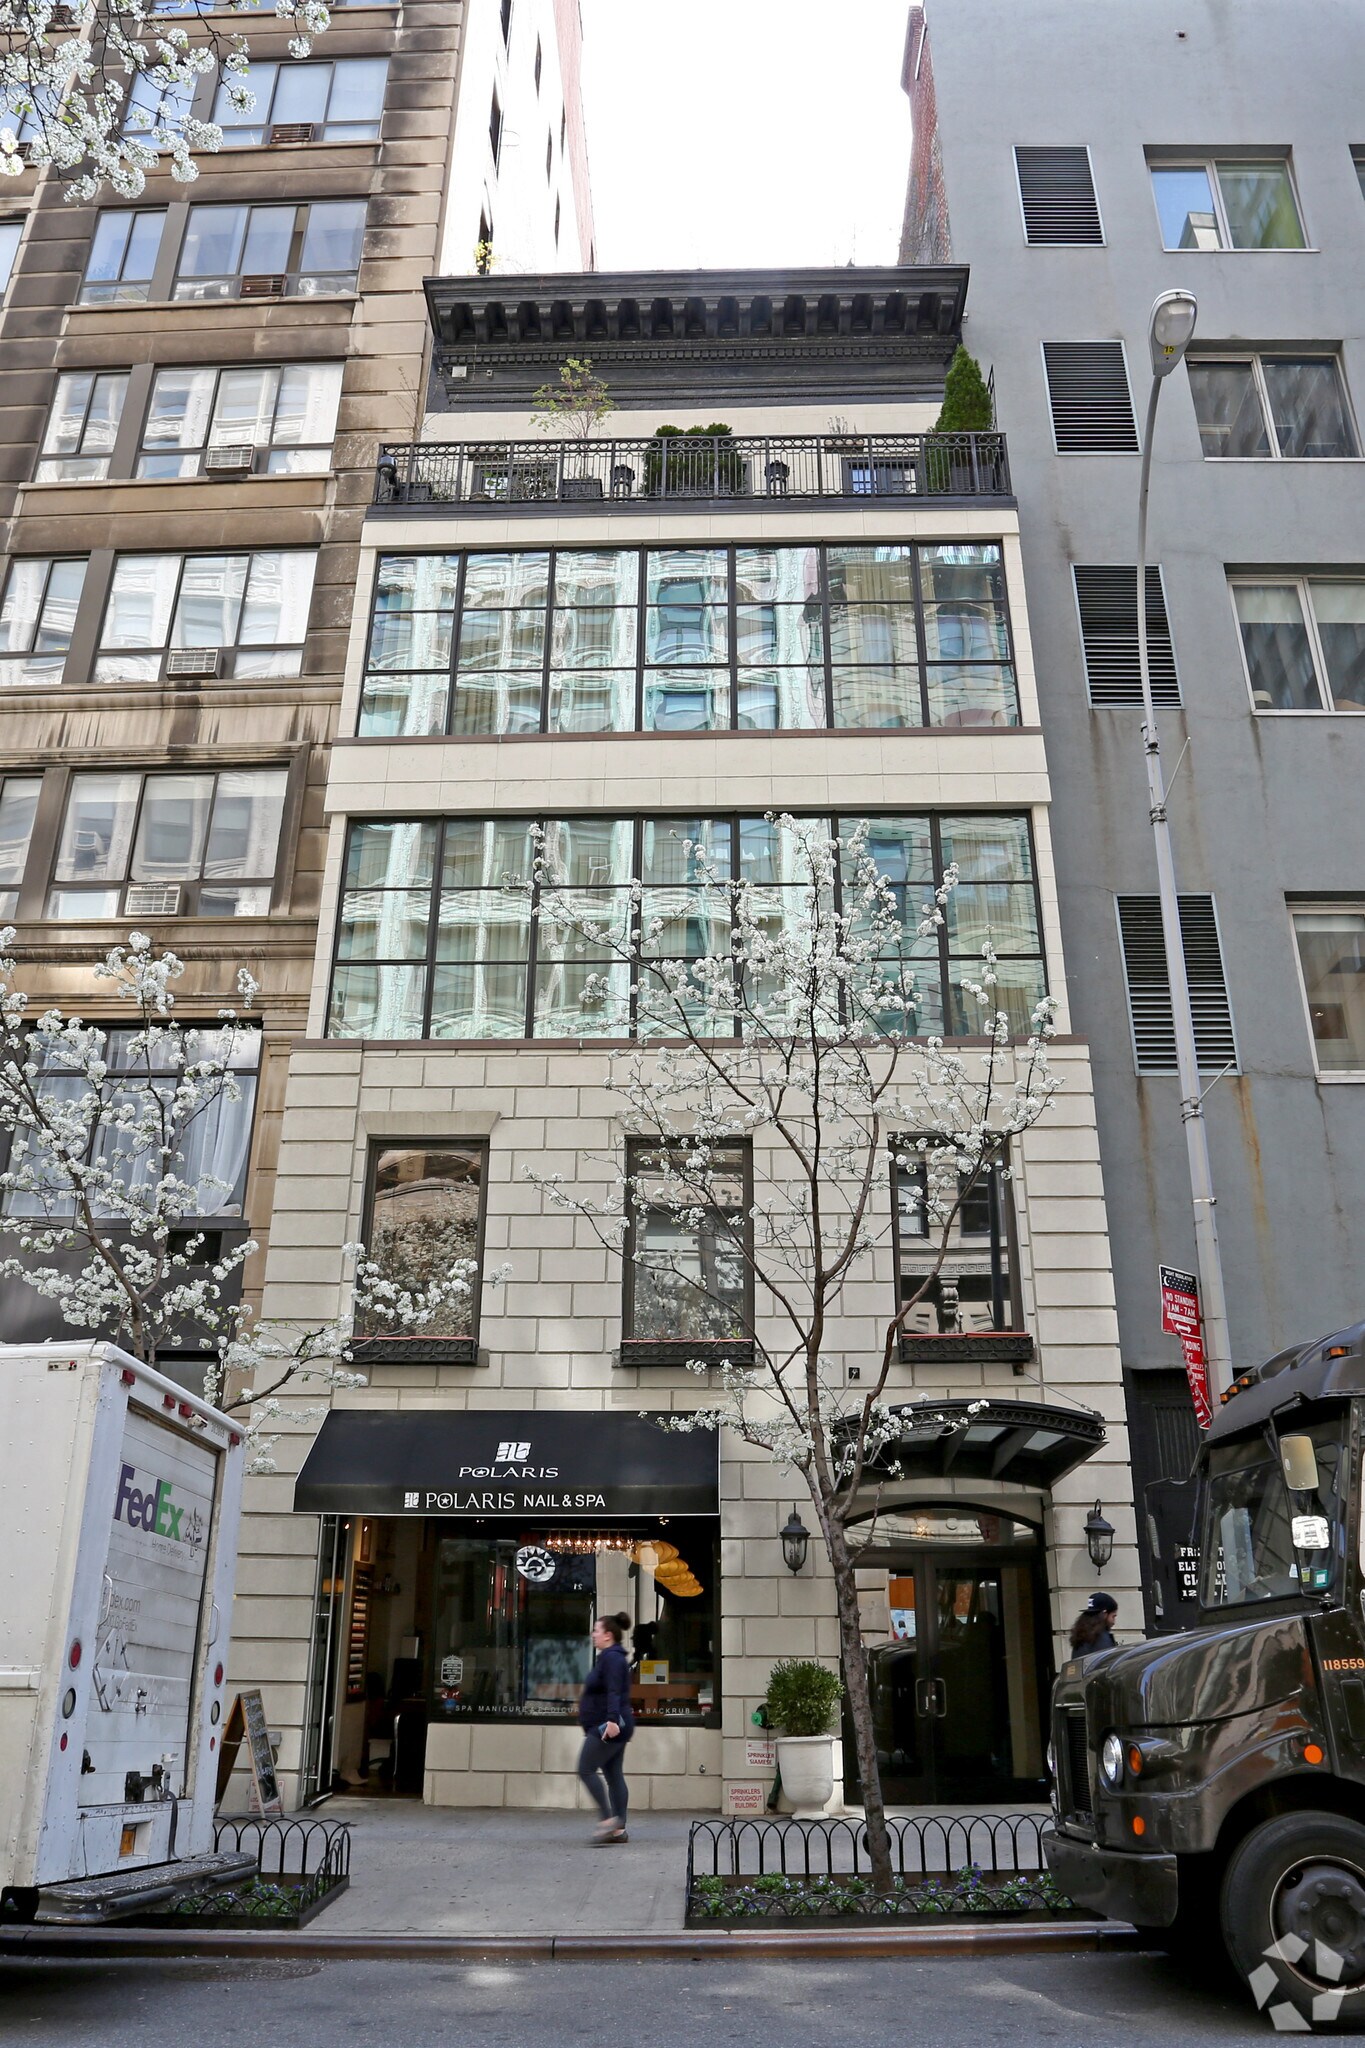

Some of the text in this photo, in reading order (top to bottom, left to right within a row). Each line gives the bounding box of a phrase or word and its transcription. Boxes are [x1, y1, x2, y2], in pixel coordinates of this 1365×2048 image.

[1165, 1292, 1196, 1308] NO STANDING
[458, 1467, 559, 1478] POLARIS
[113, 1463, 184, 1541] FedEx
[425, 1492, 606, 1509] POLARIS NAIL & SPA
[1323, 1658, 1365, 1670] 118559
[478, 1705, 527, 1713] MANICURE
